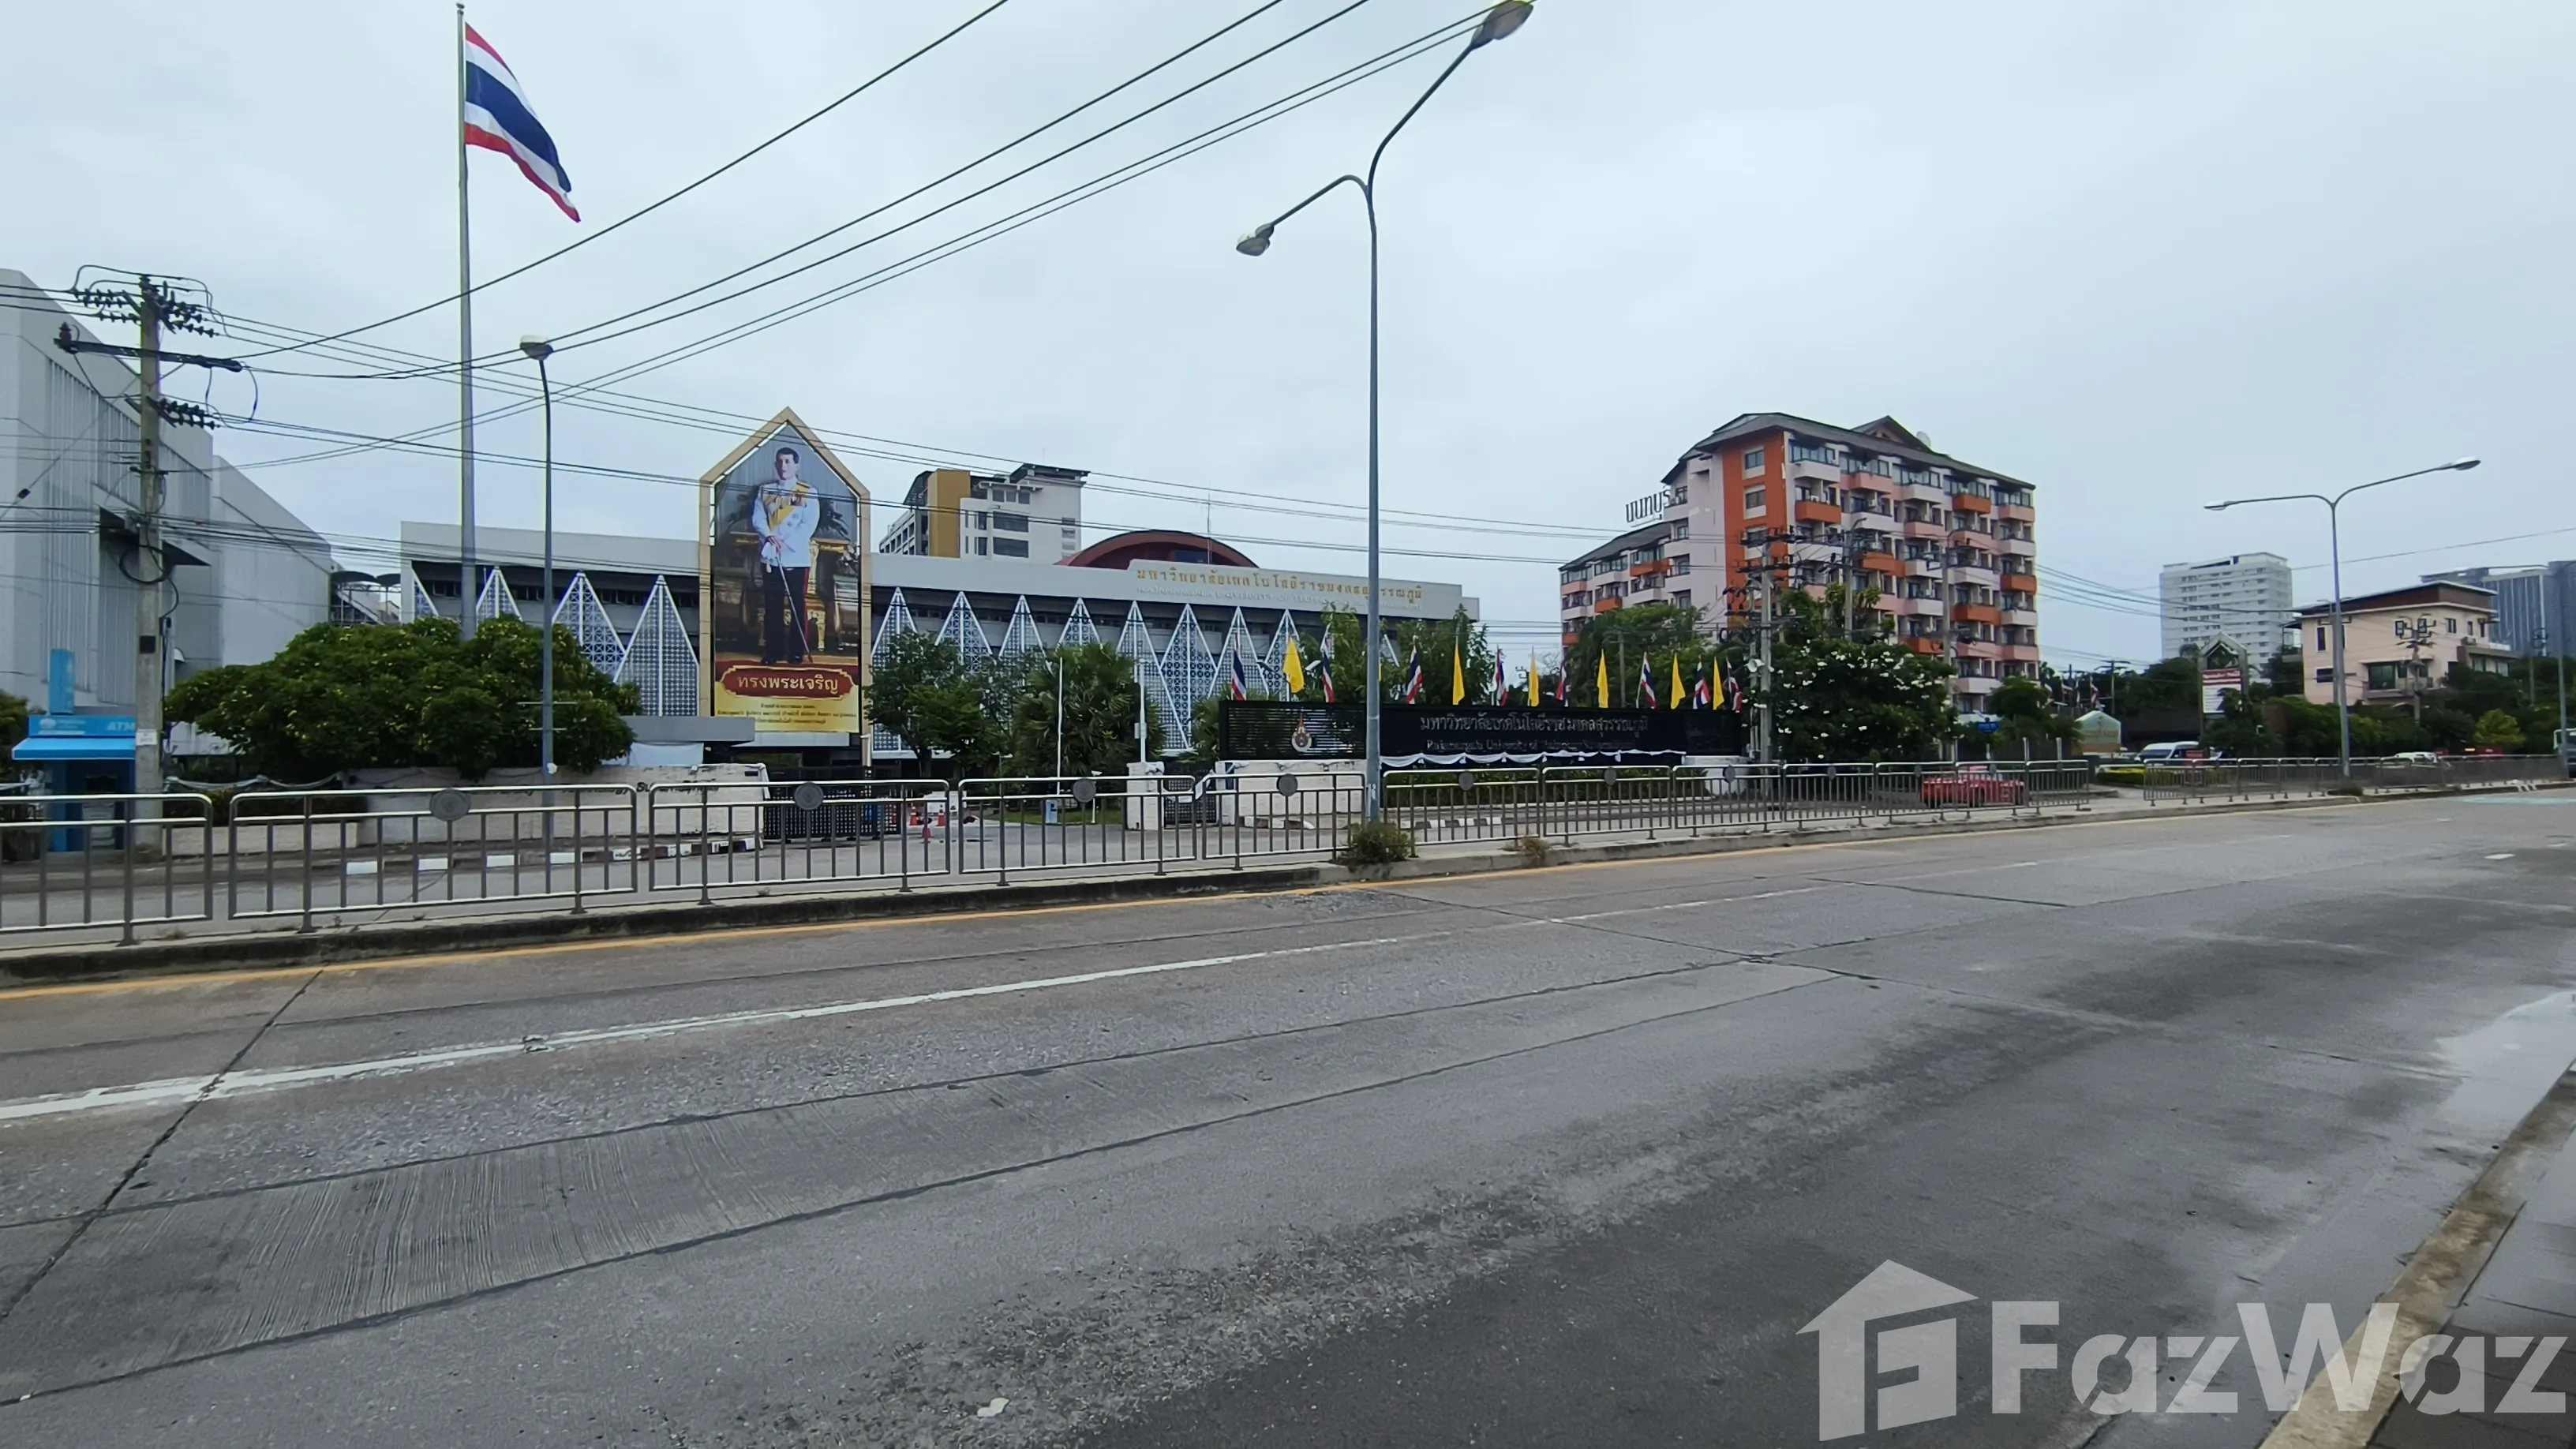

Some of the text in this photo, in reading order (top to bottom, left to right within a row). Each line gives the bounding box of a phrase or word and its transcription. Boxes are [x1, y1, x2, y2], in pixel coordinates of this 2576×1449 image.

[737, 674, 839, 695] ทรงพระเจริญ
